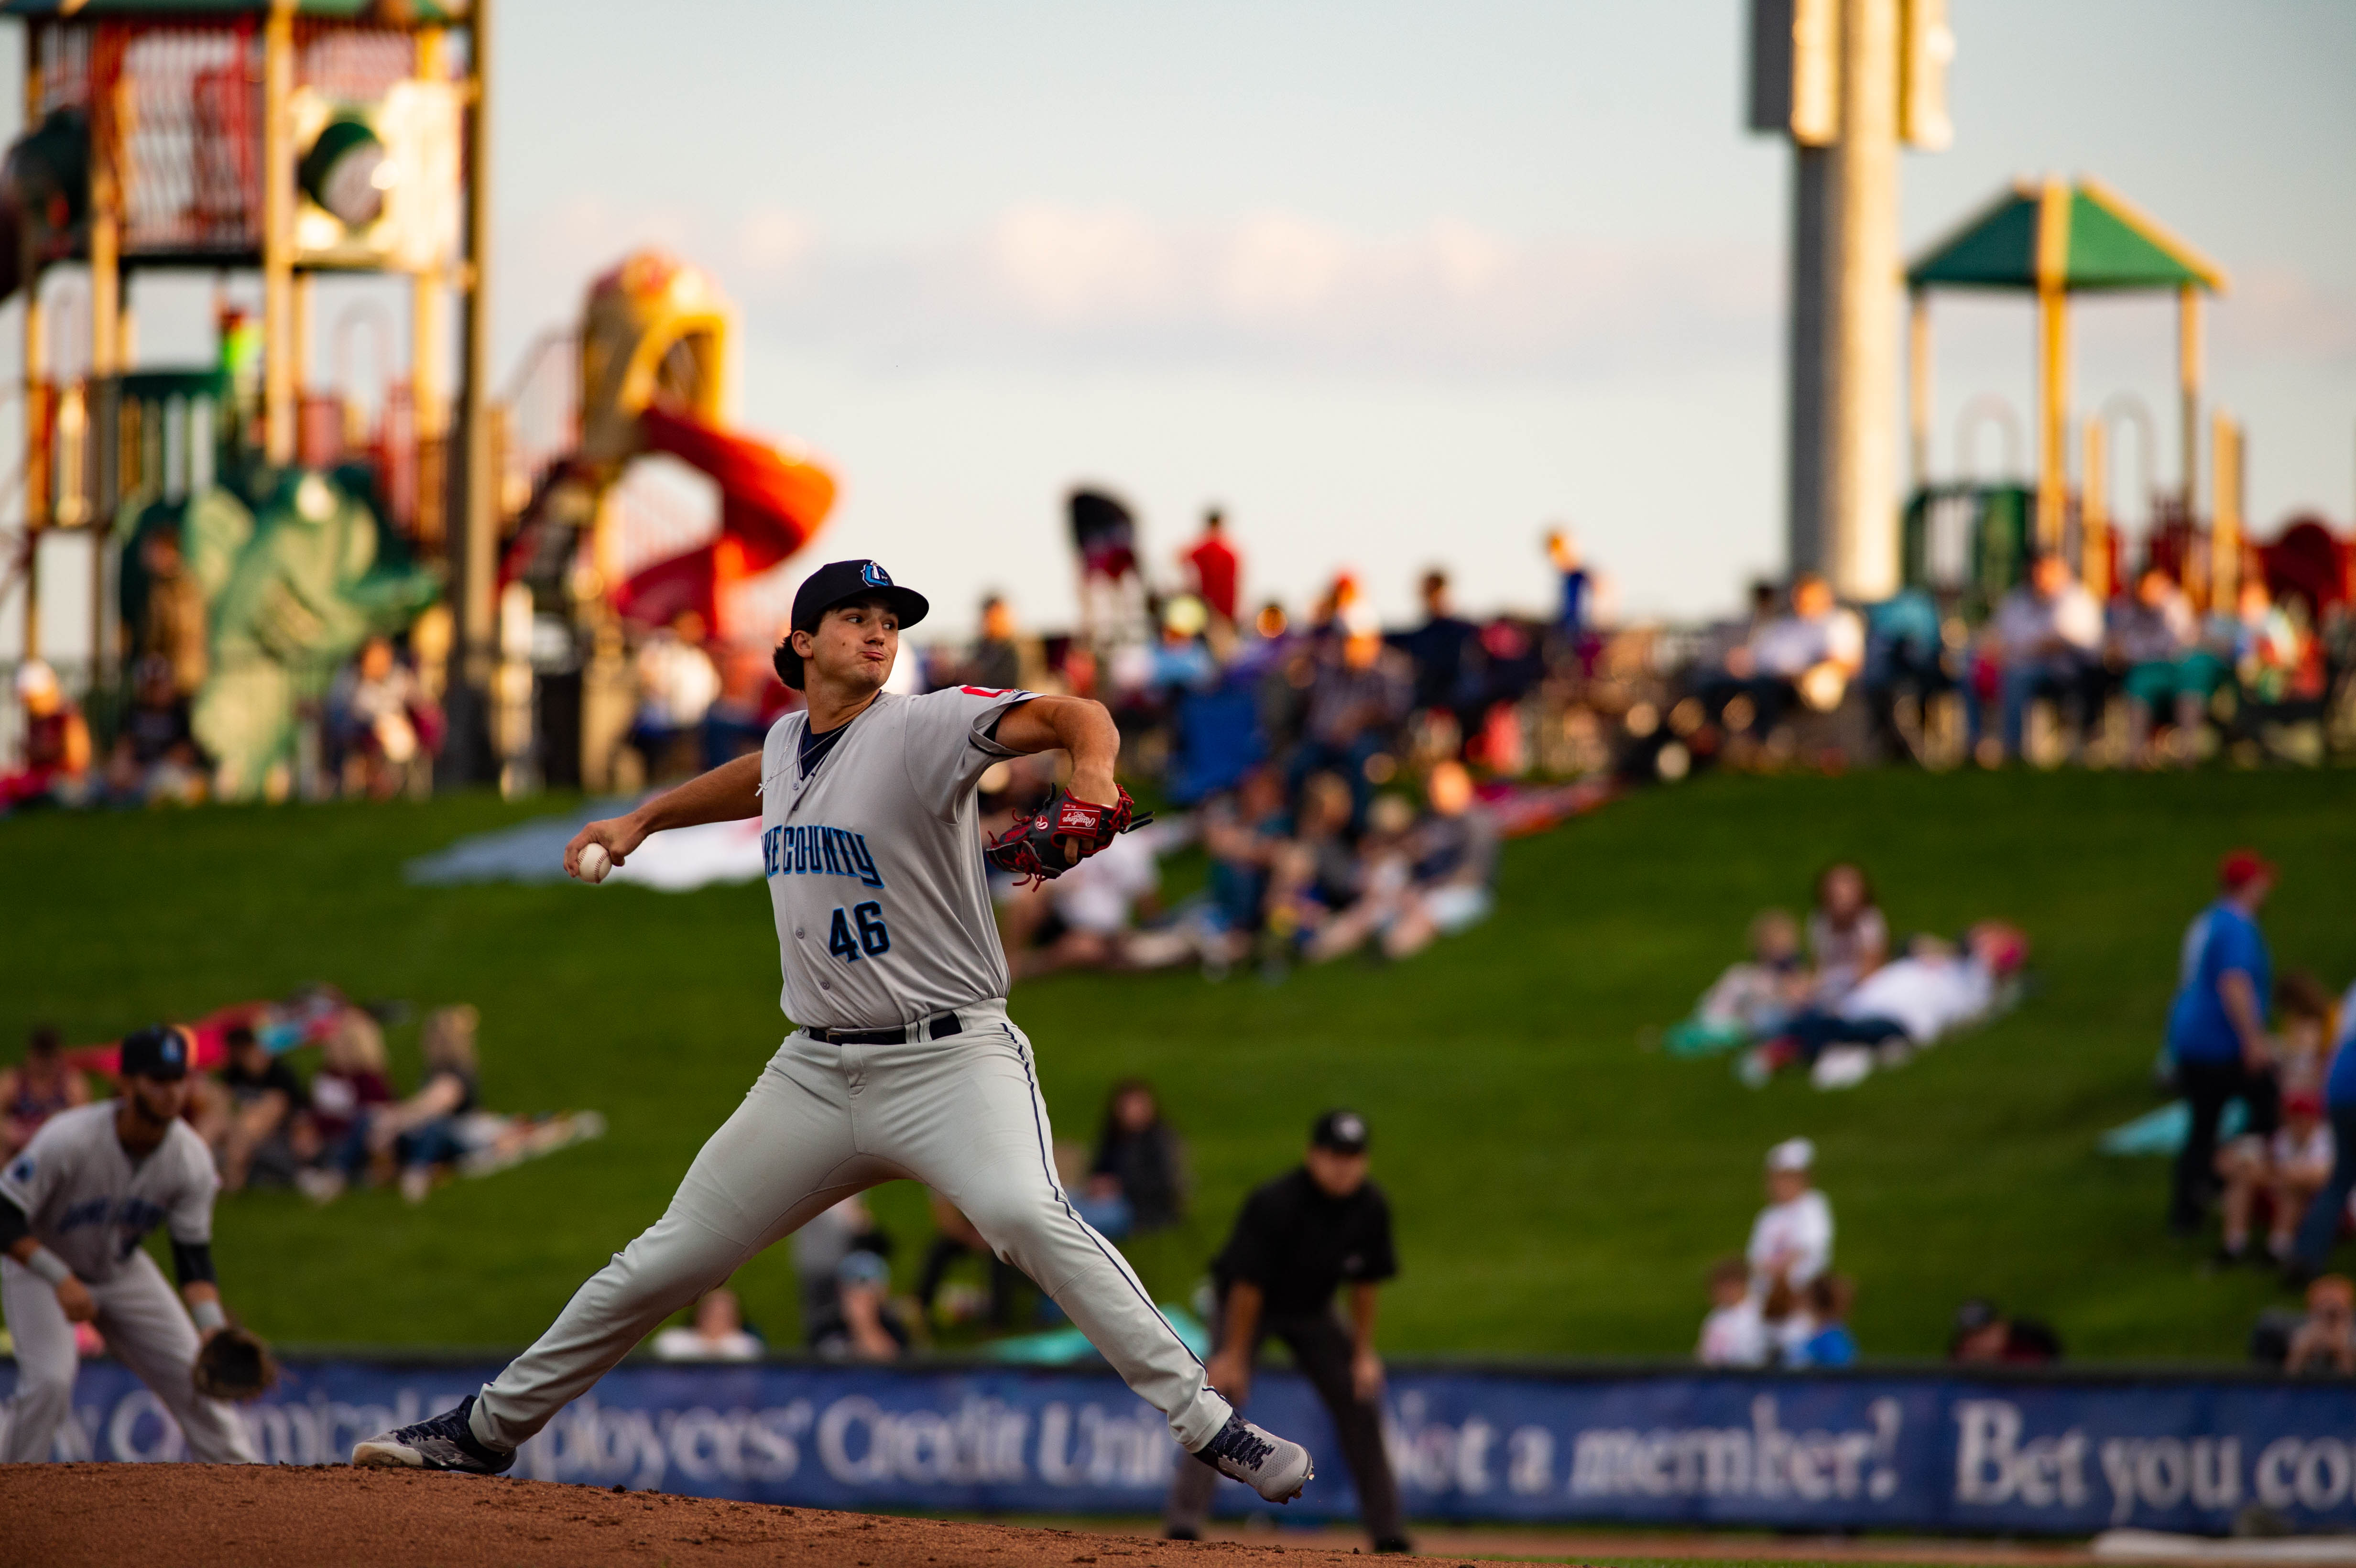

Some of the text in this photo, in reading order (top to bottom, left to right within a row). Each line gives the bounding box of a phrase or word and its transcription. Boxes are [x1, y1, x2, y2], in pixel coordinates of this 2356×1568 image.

[1062, 812, 1096, 827] Rawlings
[761, 825, 884, 889] KE COUNTY
[829, 900, 891, 963] 46
[818, 1394, 1030, 1486] Credit
[1036, 1402, 1210, 1486] Uni
[1508, 1425, 1554, 1496] a
[1952, 1399, 2086, 1508] Bet
[2100, 1435, 2243, 1527] you
[2255, 1436, 2356, 1512] co
